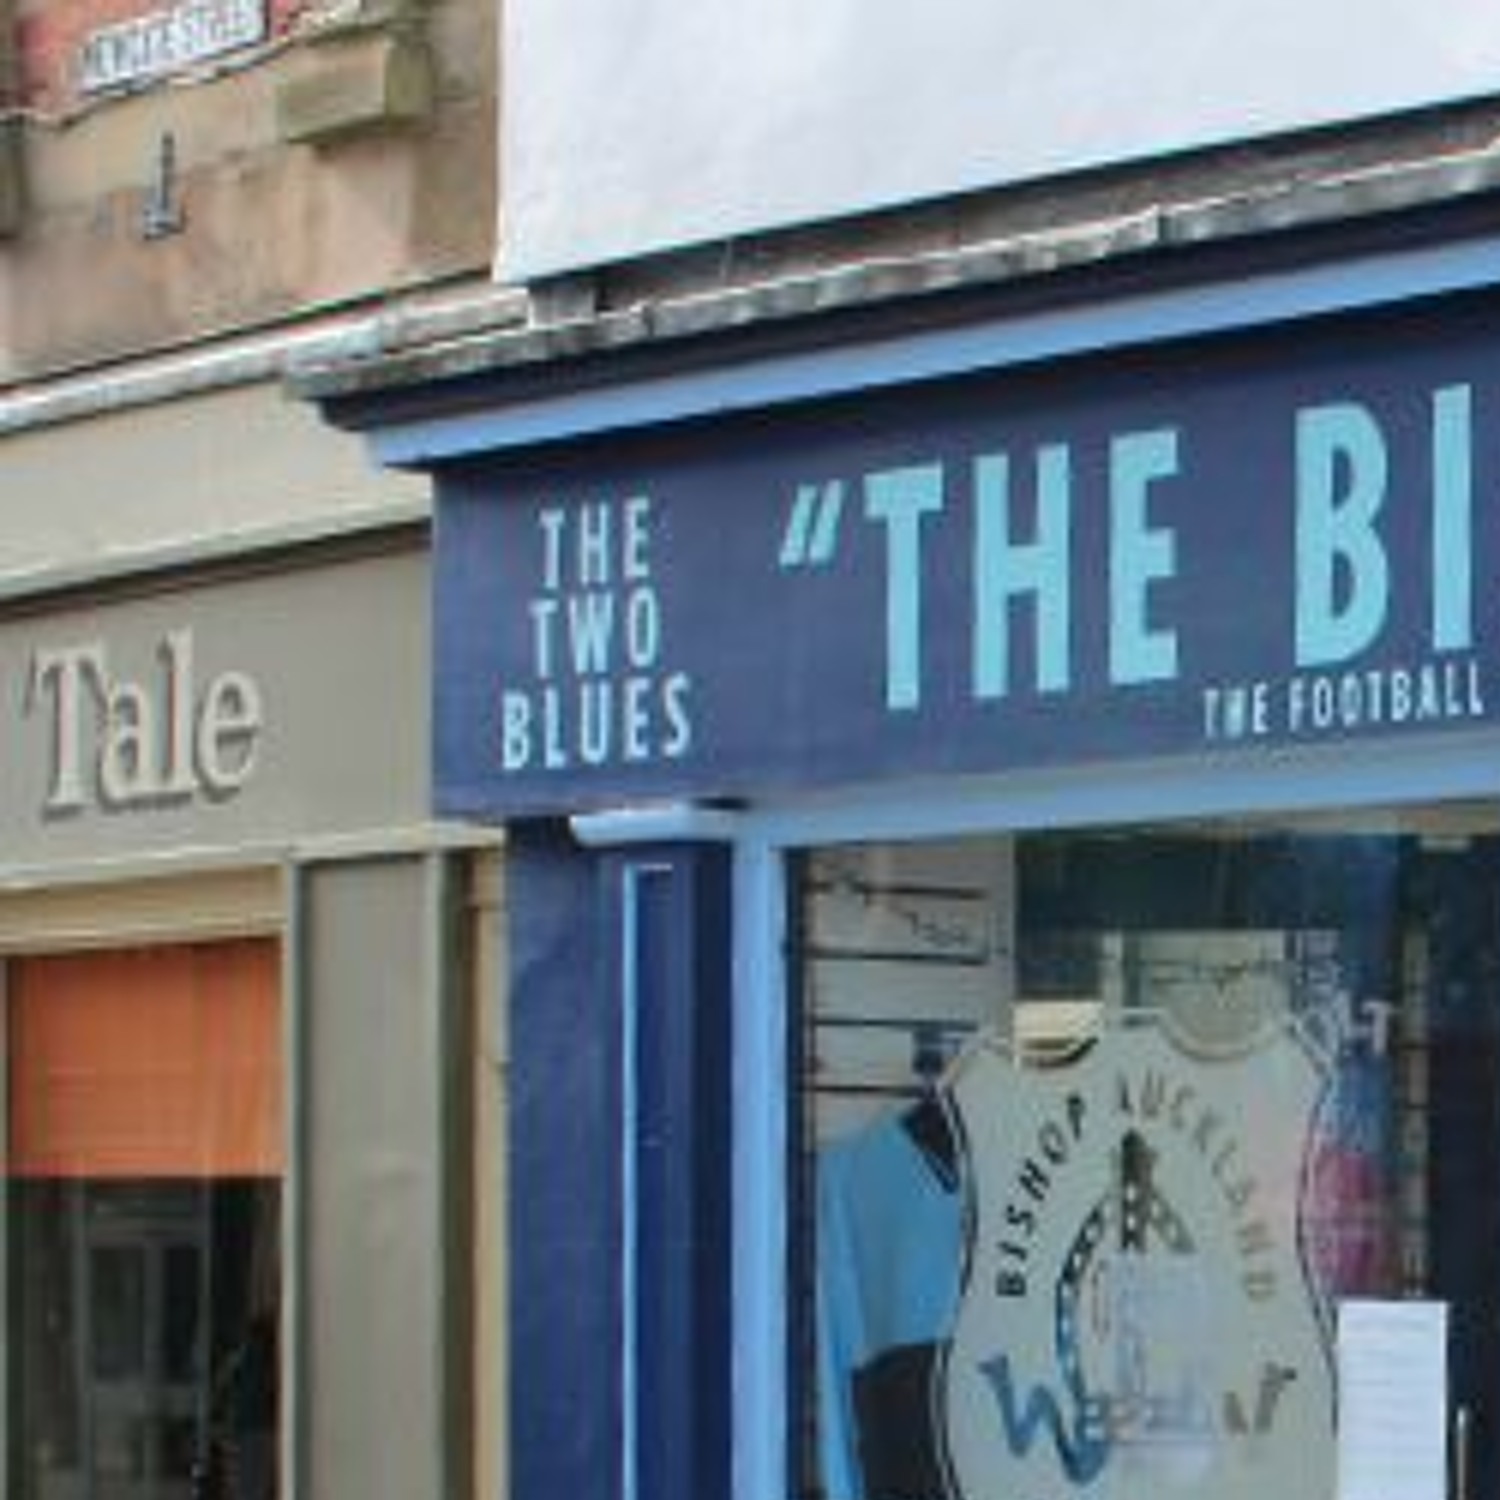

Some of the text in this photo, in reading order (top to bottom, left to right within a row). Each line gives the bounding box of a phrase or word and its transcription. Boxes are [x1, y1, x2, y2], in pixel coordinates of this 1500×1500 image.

[540, 496, 651, 592] THE
[531, 587, 661, 680] TWO
[27, 628, 261, 808] Tale
[501, 672, 693, 772] BLUES
[1204, 683, 1267, 739] THE
[1288, 660, 1484, 733] FOOTBALL
[995, 1090, 1087, 1297] BISHOP
